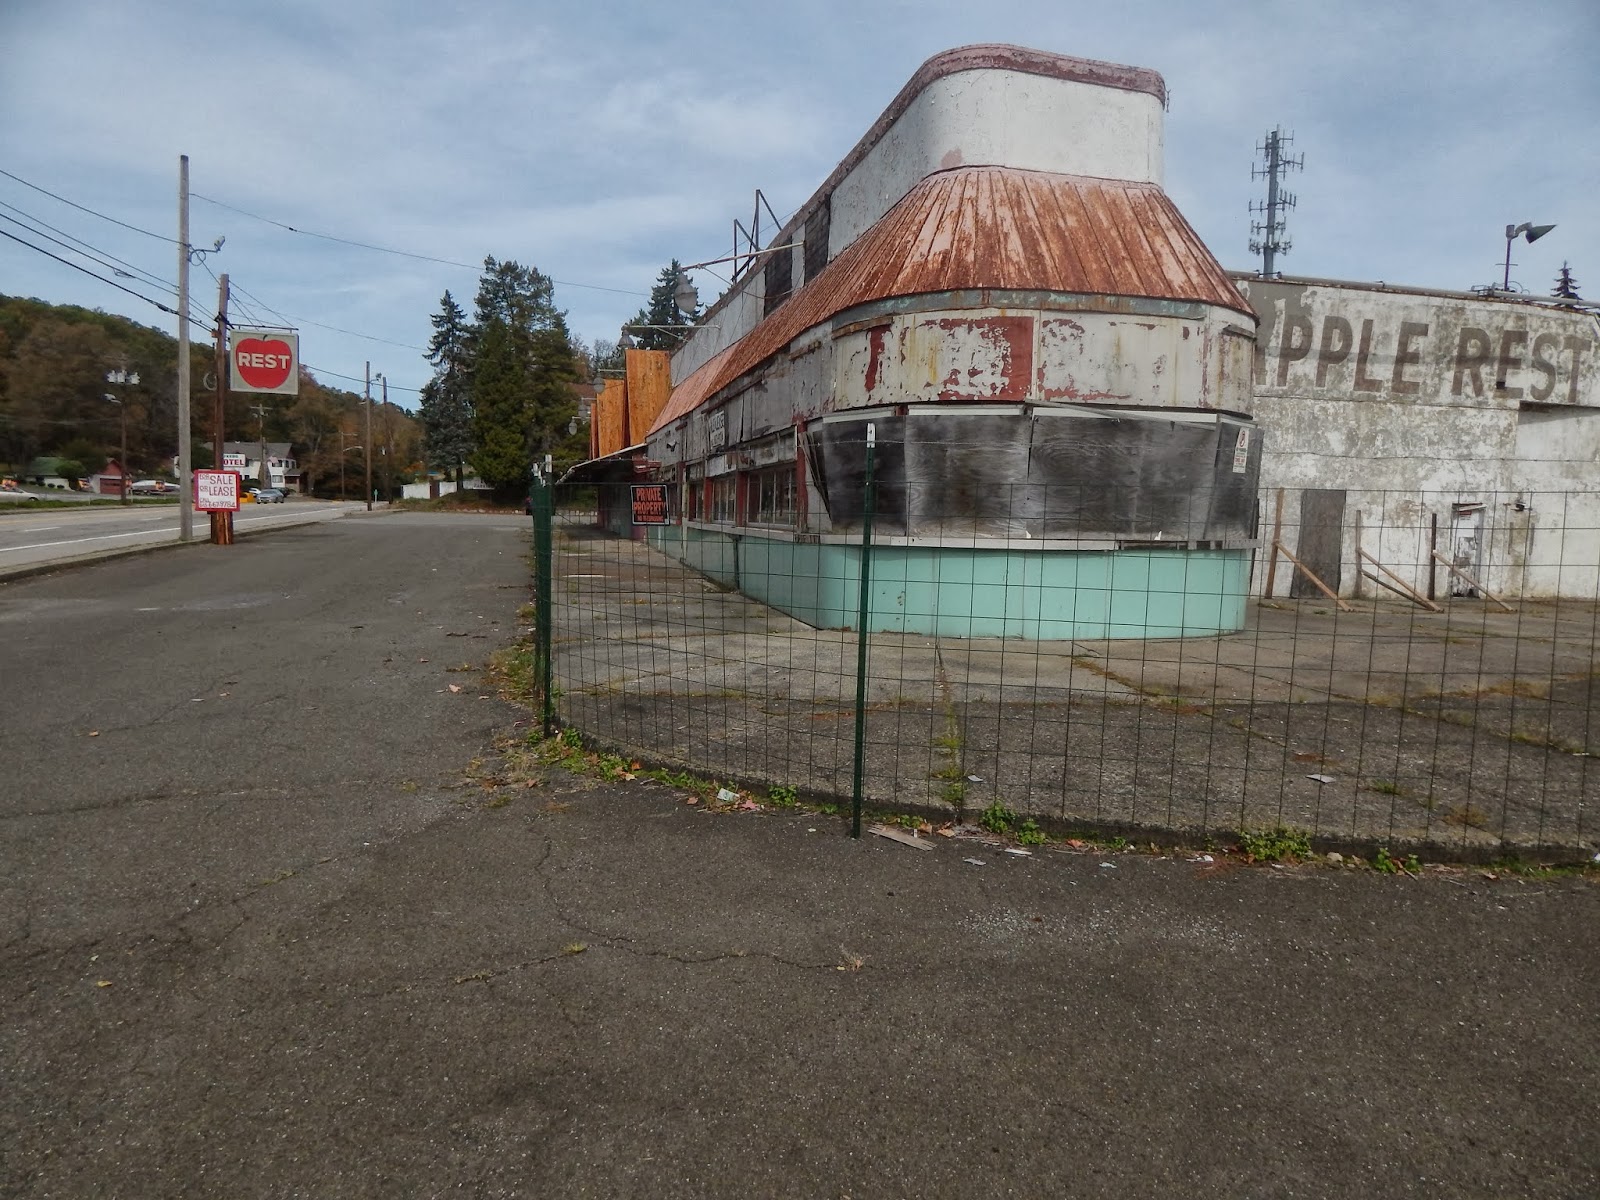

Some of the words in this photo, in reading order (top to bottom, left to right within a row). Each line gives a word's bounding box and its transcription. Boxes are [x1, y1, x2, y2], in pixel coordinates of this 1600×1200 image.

[238, 352, 290, 369] REST
[1450, 326, 1592, 403] REST
[210, 475, 233, 484] SALE
[209, 486, 235, 496] LEASE
[633, 501, 666, 515] PROPERTY
